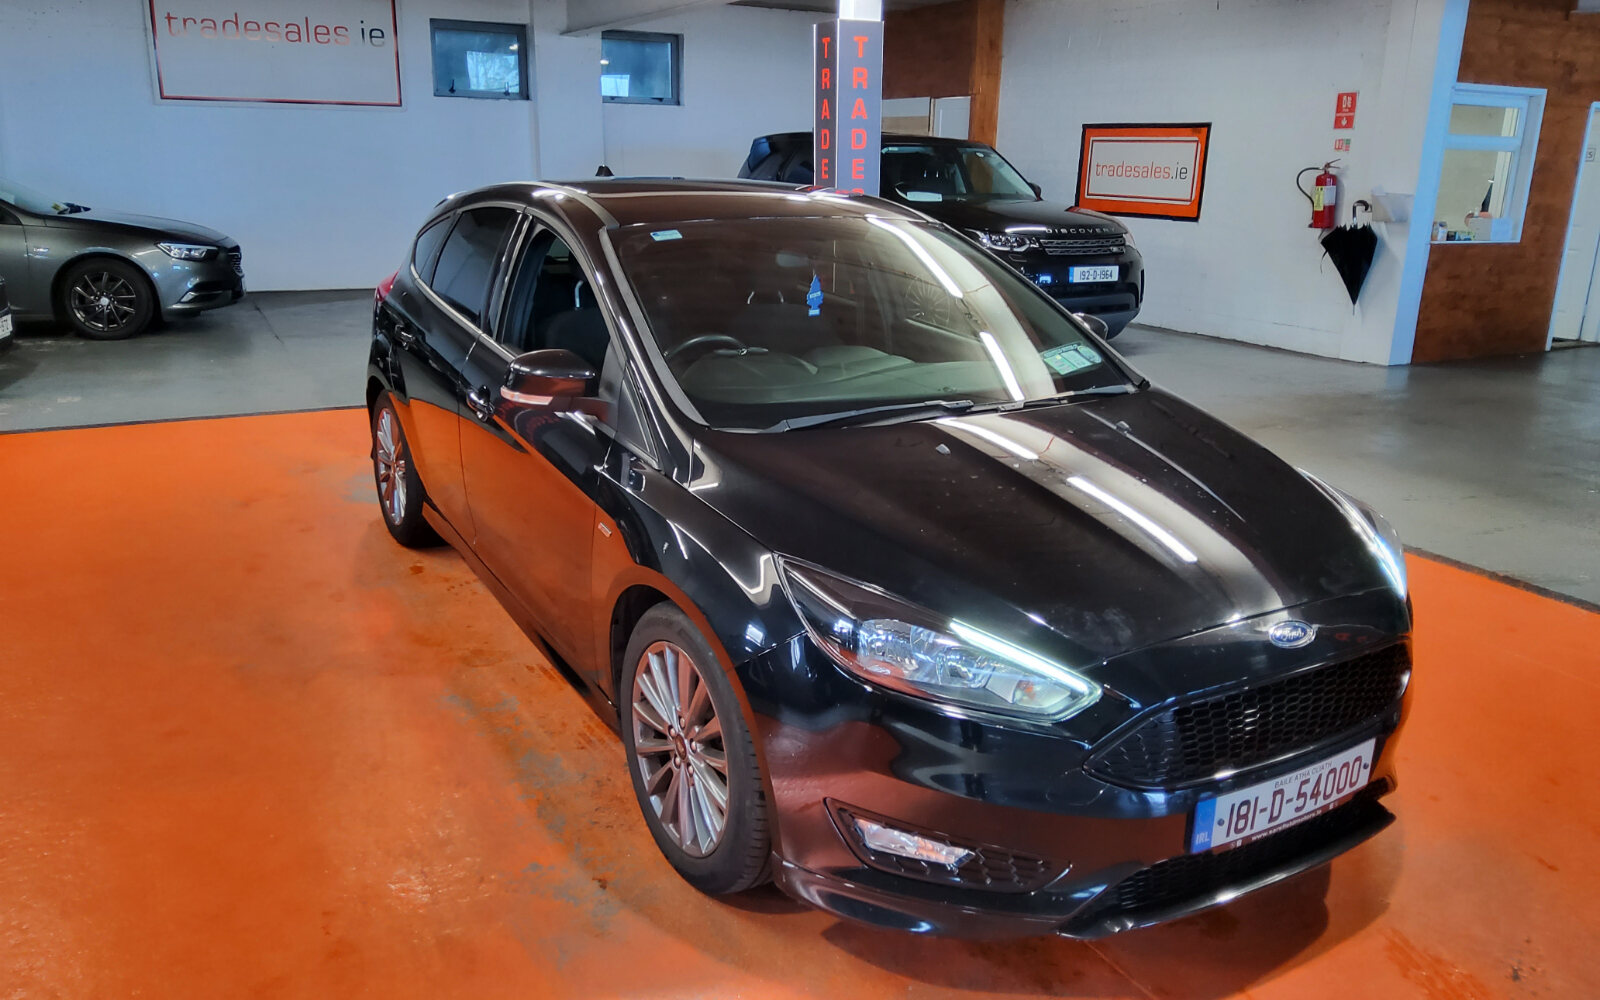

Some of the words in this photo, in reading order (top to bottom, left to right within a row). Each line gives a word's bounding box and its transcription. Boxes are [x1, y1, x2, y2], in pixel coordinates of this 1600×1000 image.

[821, 37, 831, 180] TRADE
[850, 35, 869, 194] TRADE
[1095, 161, 1188, 180] tradesales.ie
[1195, 831, 1210, 845] IRL
[1226, 755, 1362, 838] 181-D-54000
